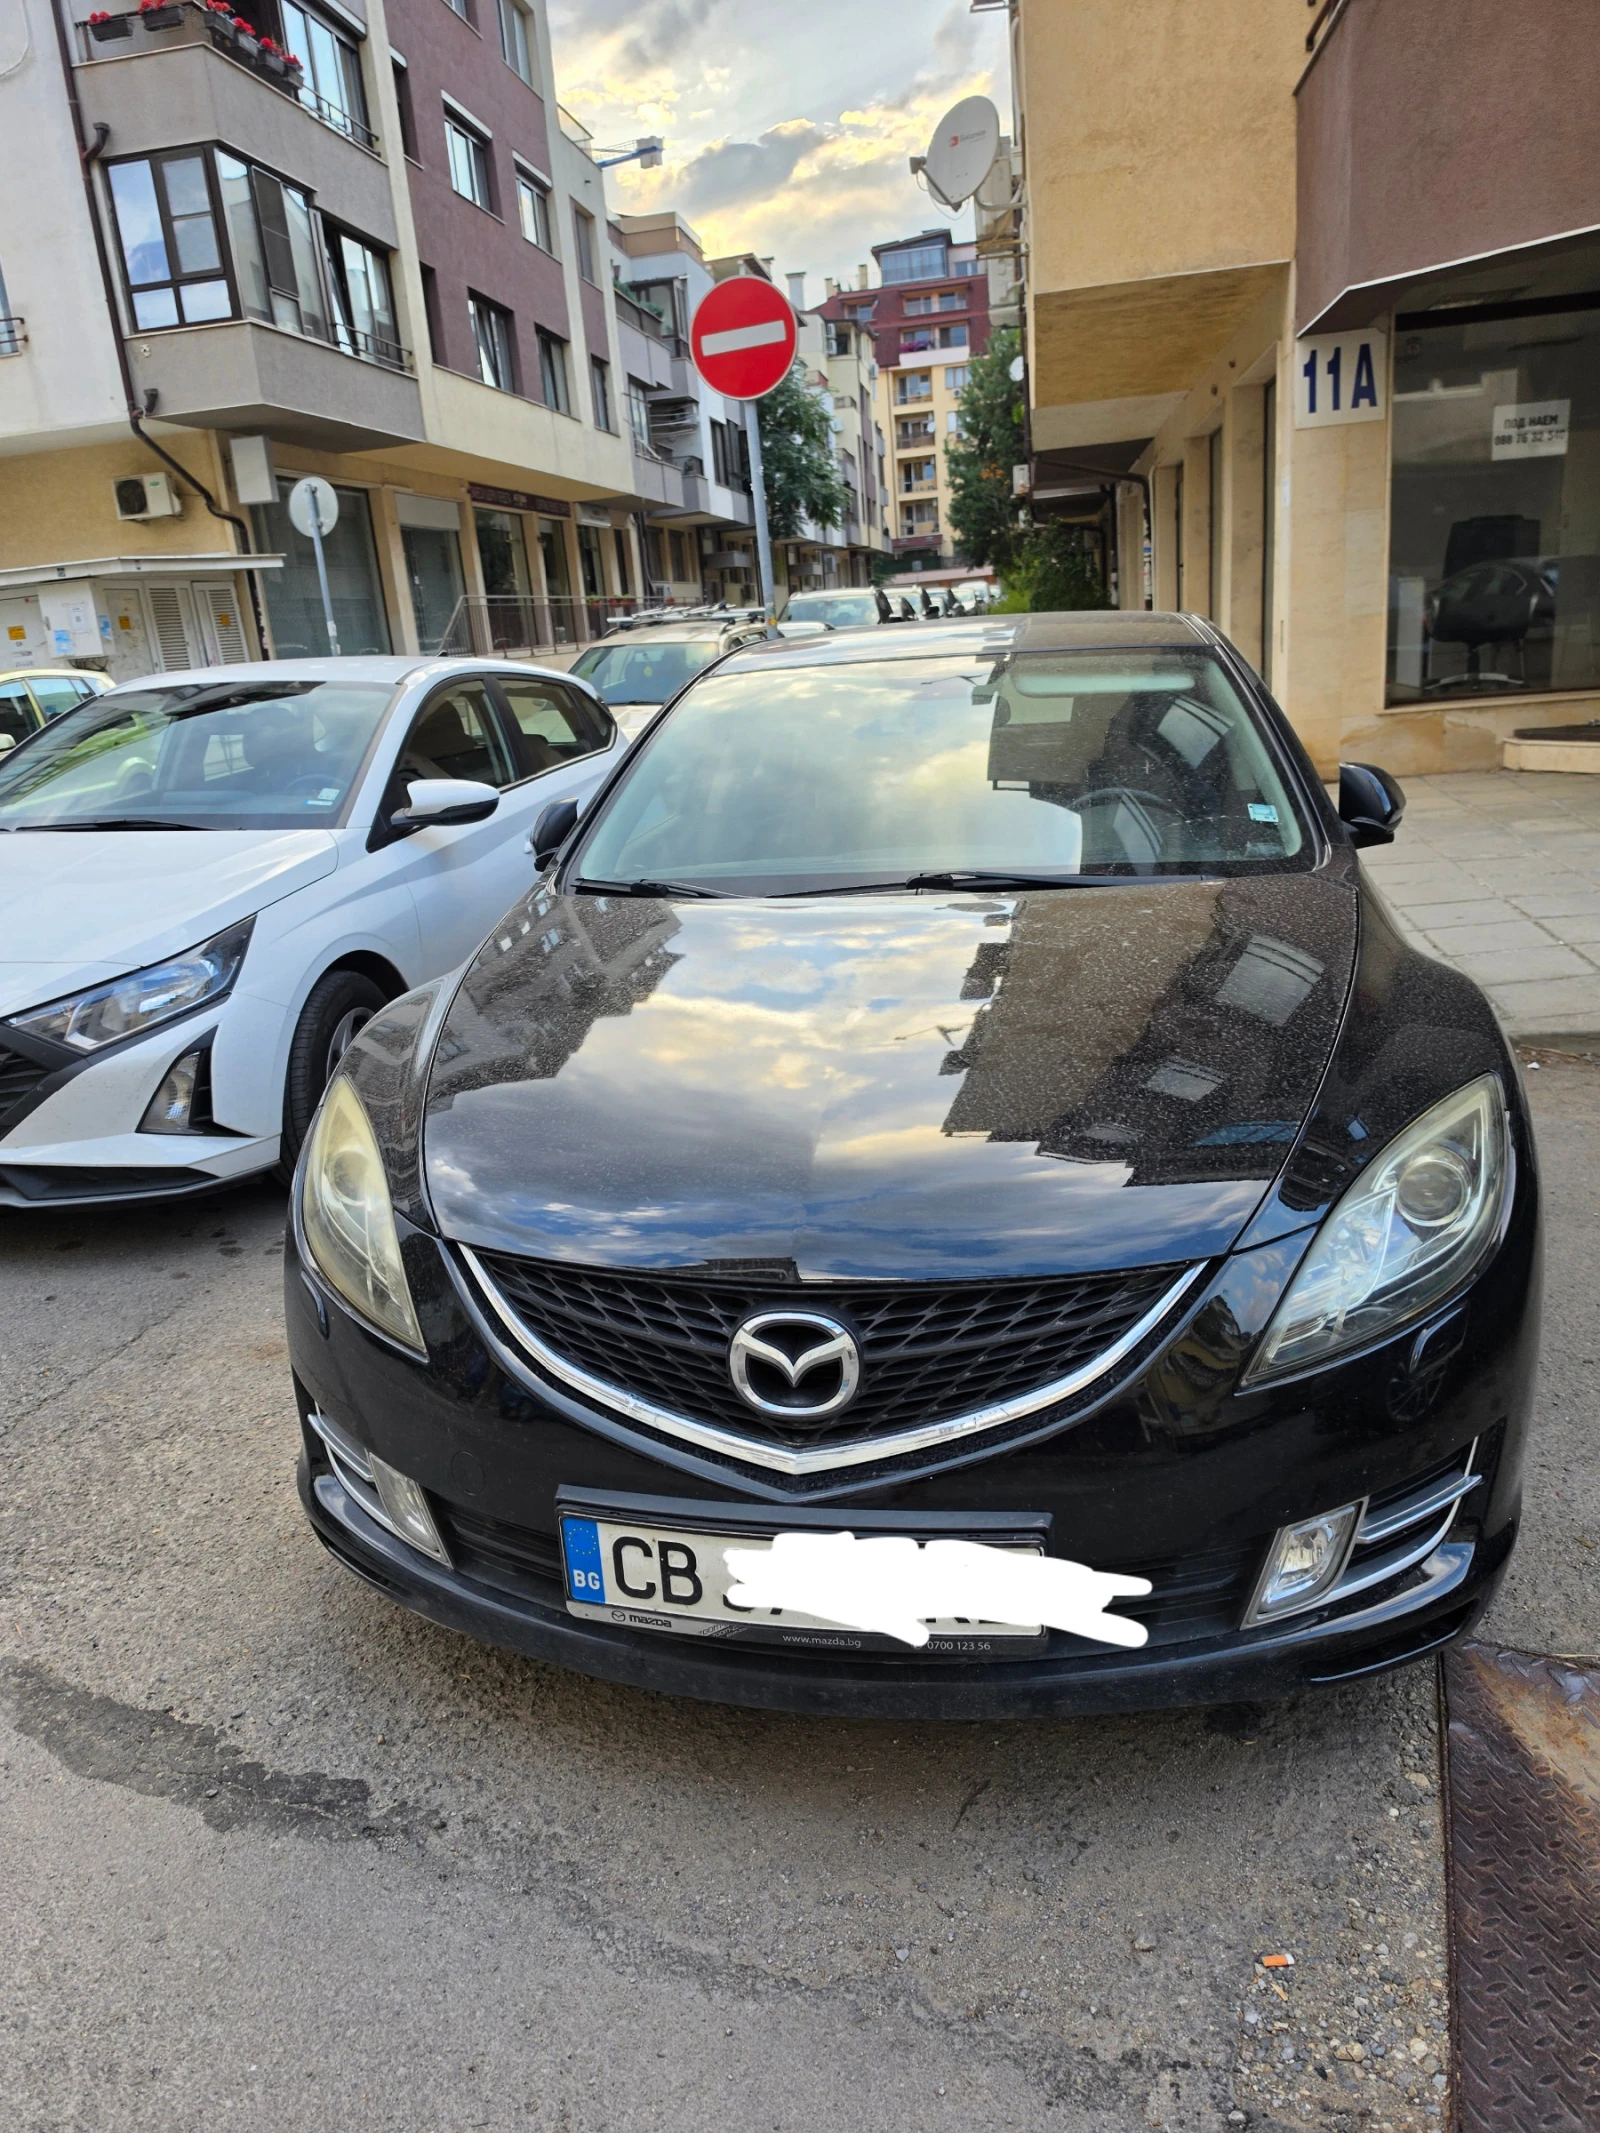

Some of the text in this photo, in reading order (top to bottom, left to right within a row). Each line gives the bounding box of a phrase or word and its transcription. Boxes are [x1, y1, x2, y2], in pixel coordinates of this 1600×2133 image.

[1303, 343, 1378, 414] 11A
[1529, 414, 1559, 427] НАЕМ
[612, 1536, 703, 1606] CB
[573, 1569, 600, 1590] BG
[629, 1613, 672, 1628] mazda
[782, 1633, 862, 1649] www.mazda.bg
[927, 1640, 991, 1651] 0700 123 56
